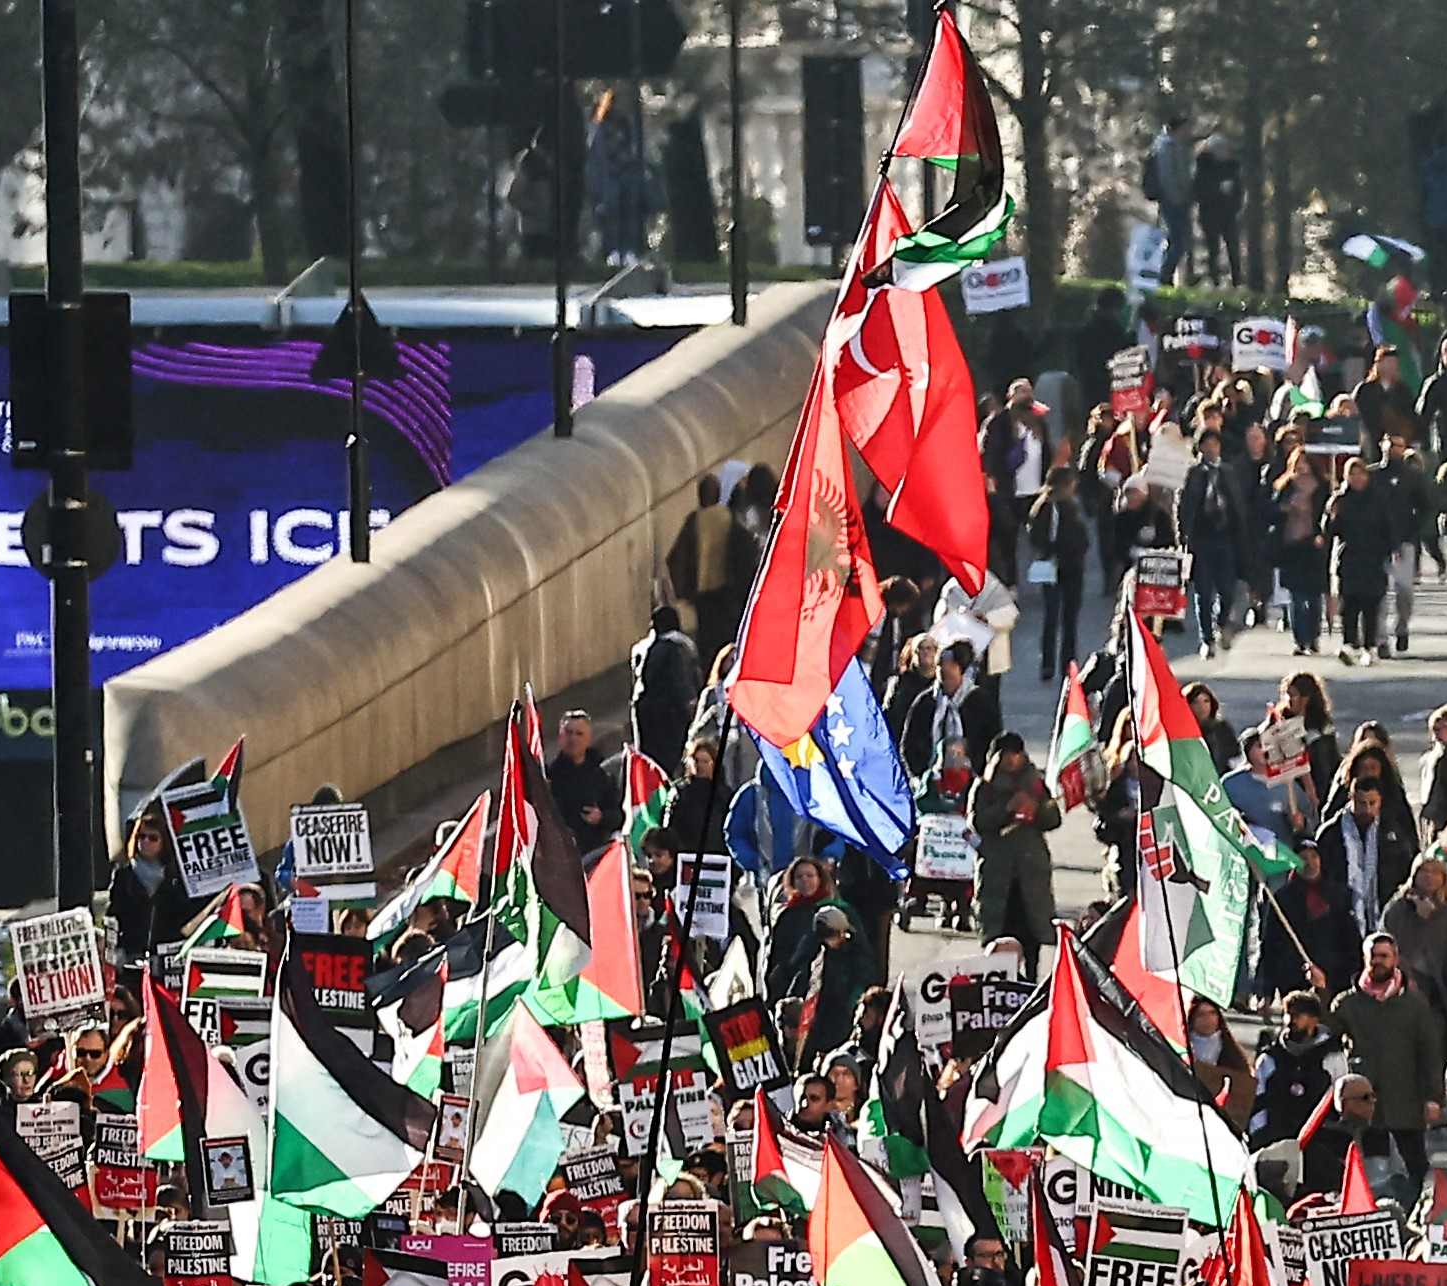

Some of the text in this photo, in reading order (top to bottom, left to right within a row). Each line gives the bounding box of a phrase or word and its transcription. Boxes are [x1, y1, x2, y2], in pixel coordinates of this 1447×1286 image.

[296, 817, 366, 837] CEASEFIRE
[178, 825, 249, 862] FREE
[306, 833, 361, 865] NOW!
[183, 848, 252, 876] PALESTINE
[27, 964, 98, 1006] RETURN!
[314, 992, 366, 1011] LESTINE
[732, 1052, 780, 1089] GAZA
[566, 1158, 615, 1181] FREEDOM
[653, 1214, 710, 1231] FREEDOM
[169, 1234, 223, 1251] FREEDOM
[1308, 1223, 1398, 1261] CEASEFIRE
[167, 1256, 227, 1275] PALESTINE
[767, 1247, 812, 1273] Fre
